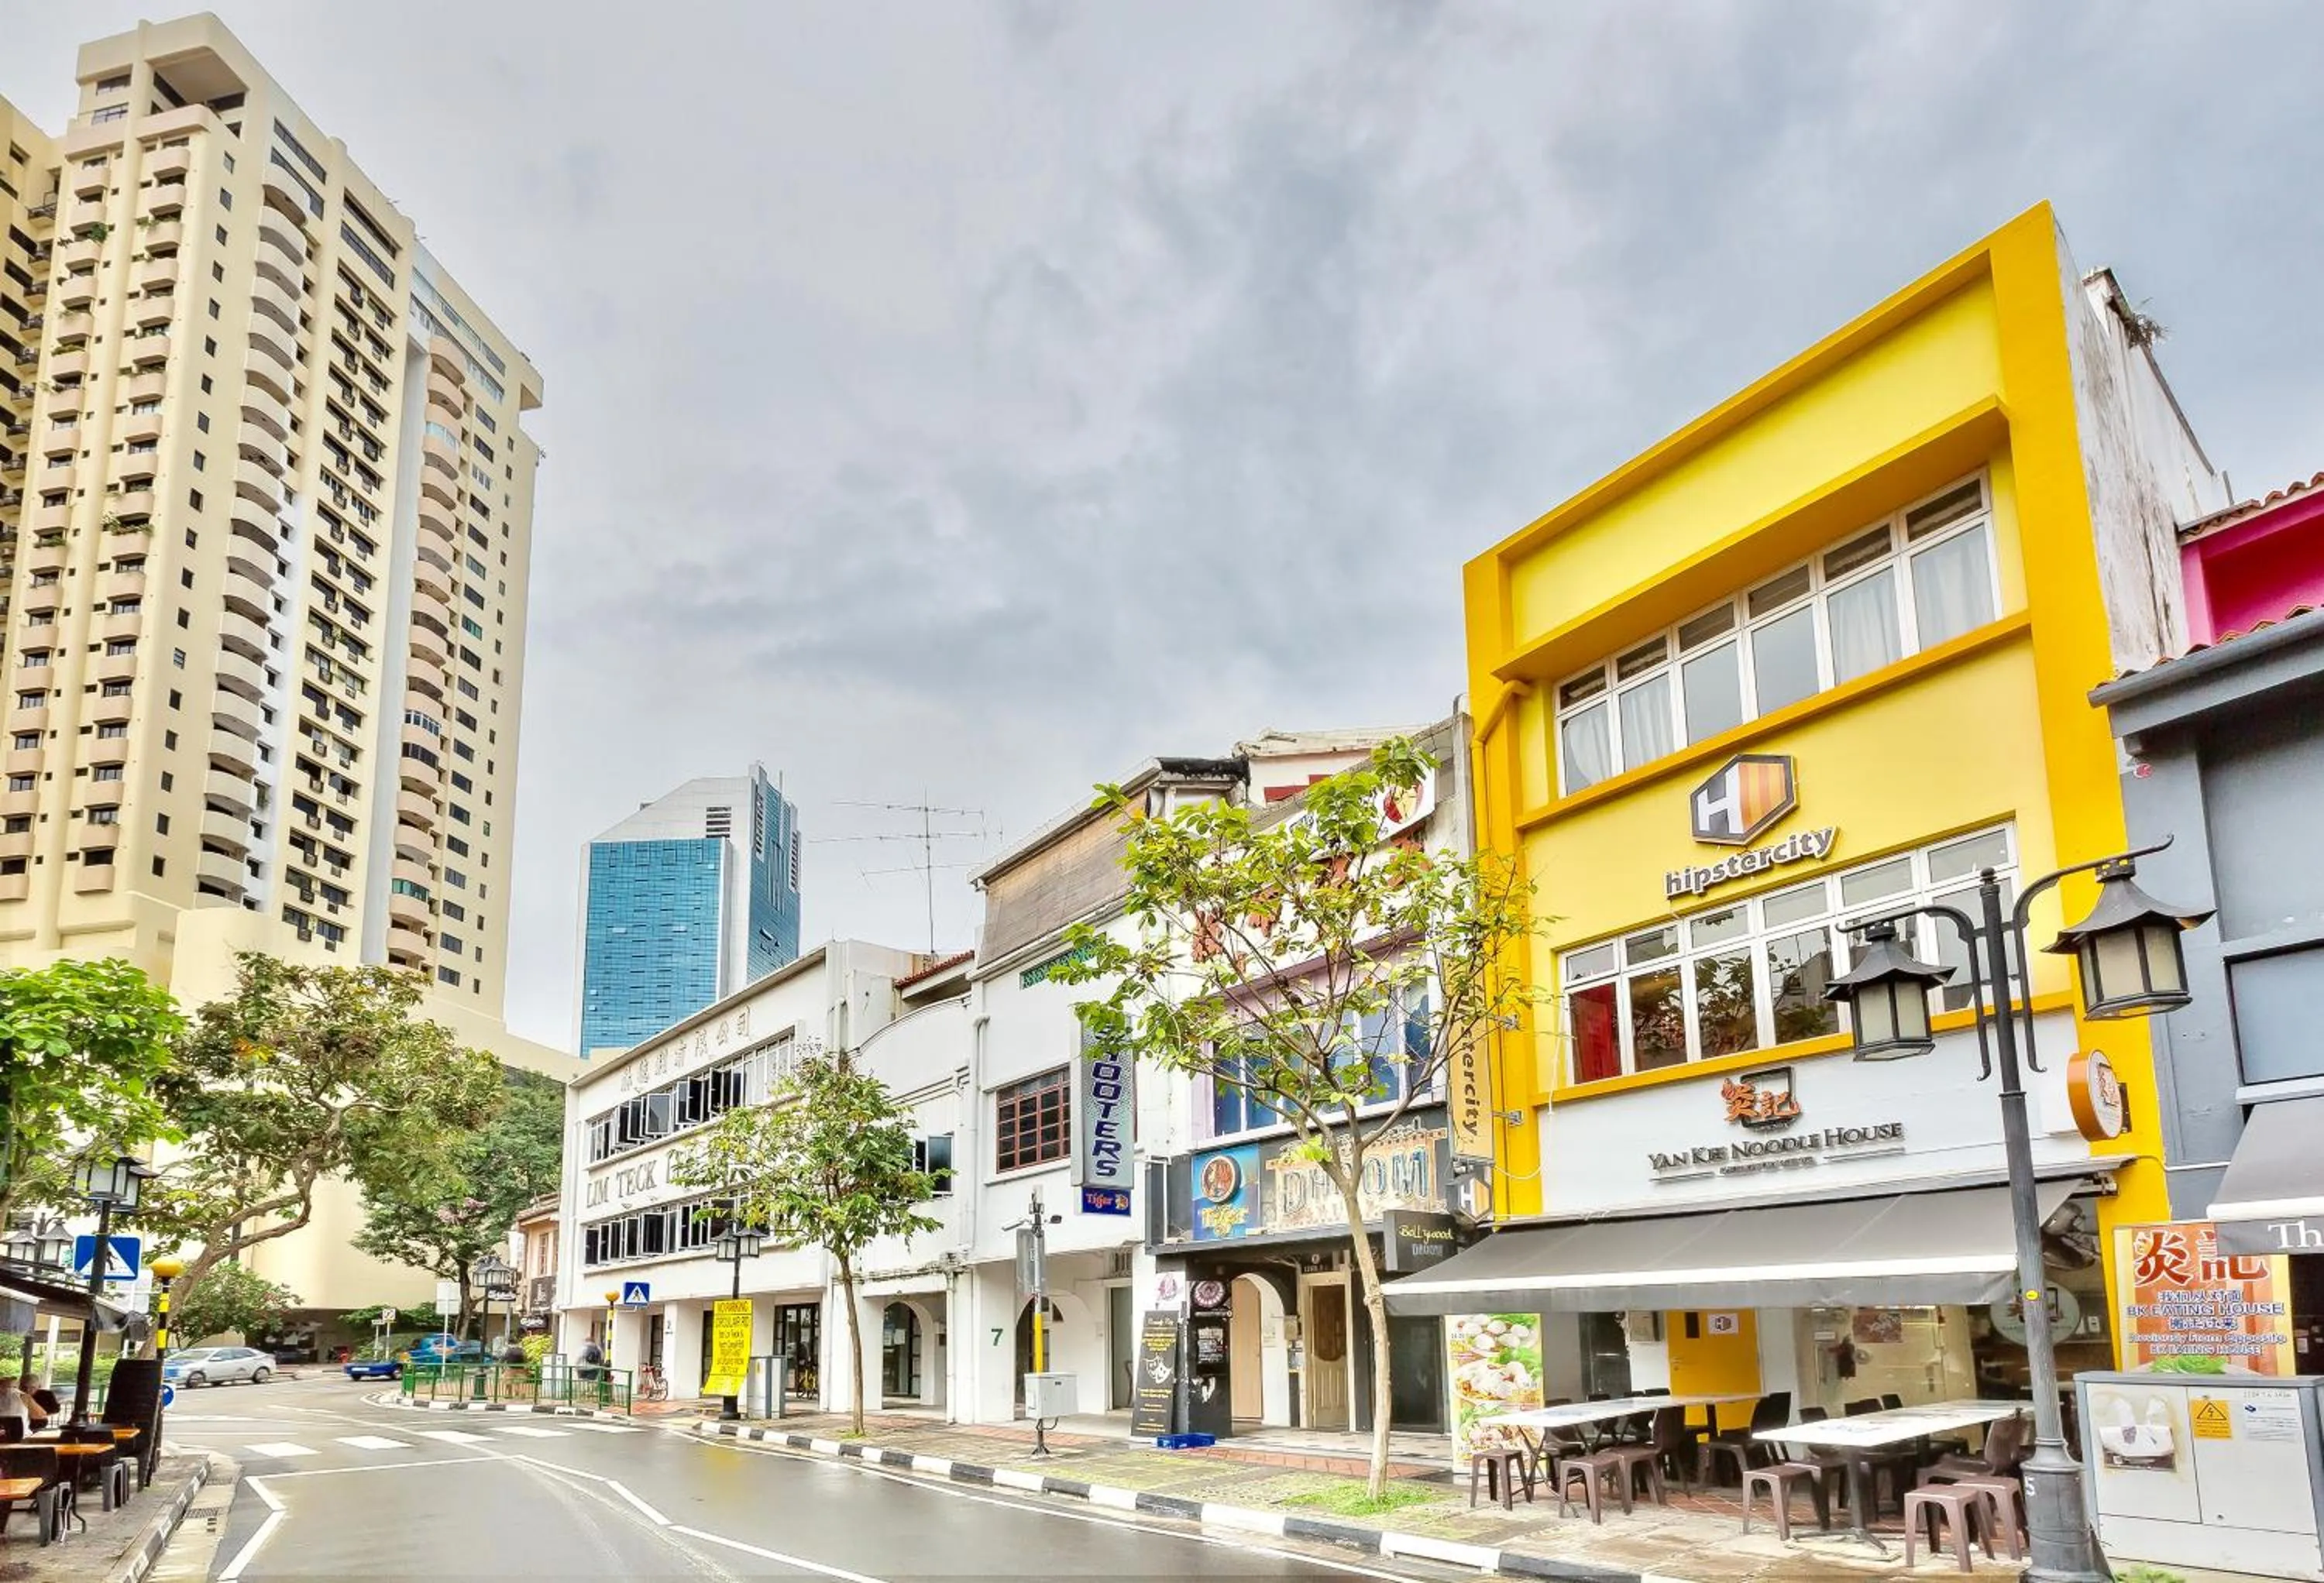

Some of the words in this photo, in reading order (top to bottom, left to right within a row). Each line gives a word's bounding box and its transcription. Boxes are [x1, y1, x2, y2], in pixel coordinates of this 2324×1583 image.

[1666, 826, 1836, 895] hipstercity
[1092, 1022, 1122, 1177] OOTERS
[1648, 1152, 1690, 1170] YAN
[1731, 1133, 1820, 1160] NOODLE
[1824, 1122, 1903, 1147] HOUSE
[587, 1176, 609, 1208] LIM
[617, 1160, 657, 1198] TECK
[1085, 1193, 1113, 1209] Tiger
[1398, 1225, 1454, 1244] Bollywood
[2152, 1304, 2214, 1317] EATING
[2219, 1303, 2284, 1315] HOUSE
[991, 1328, 1004, 1347] 7
